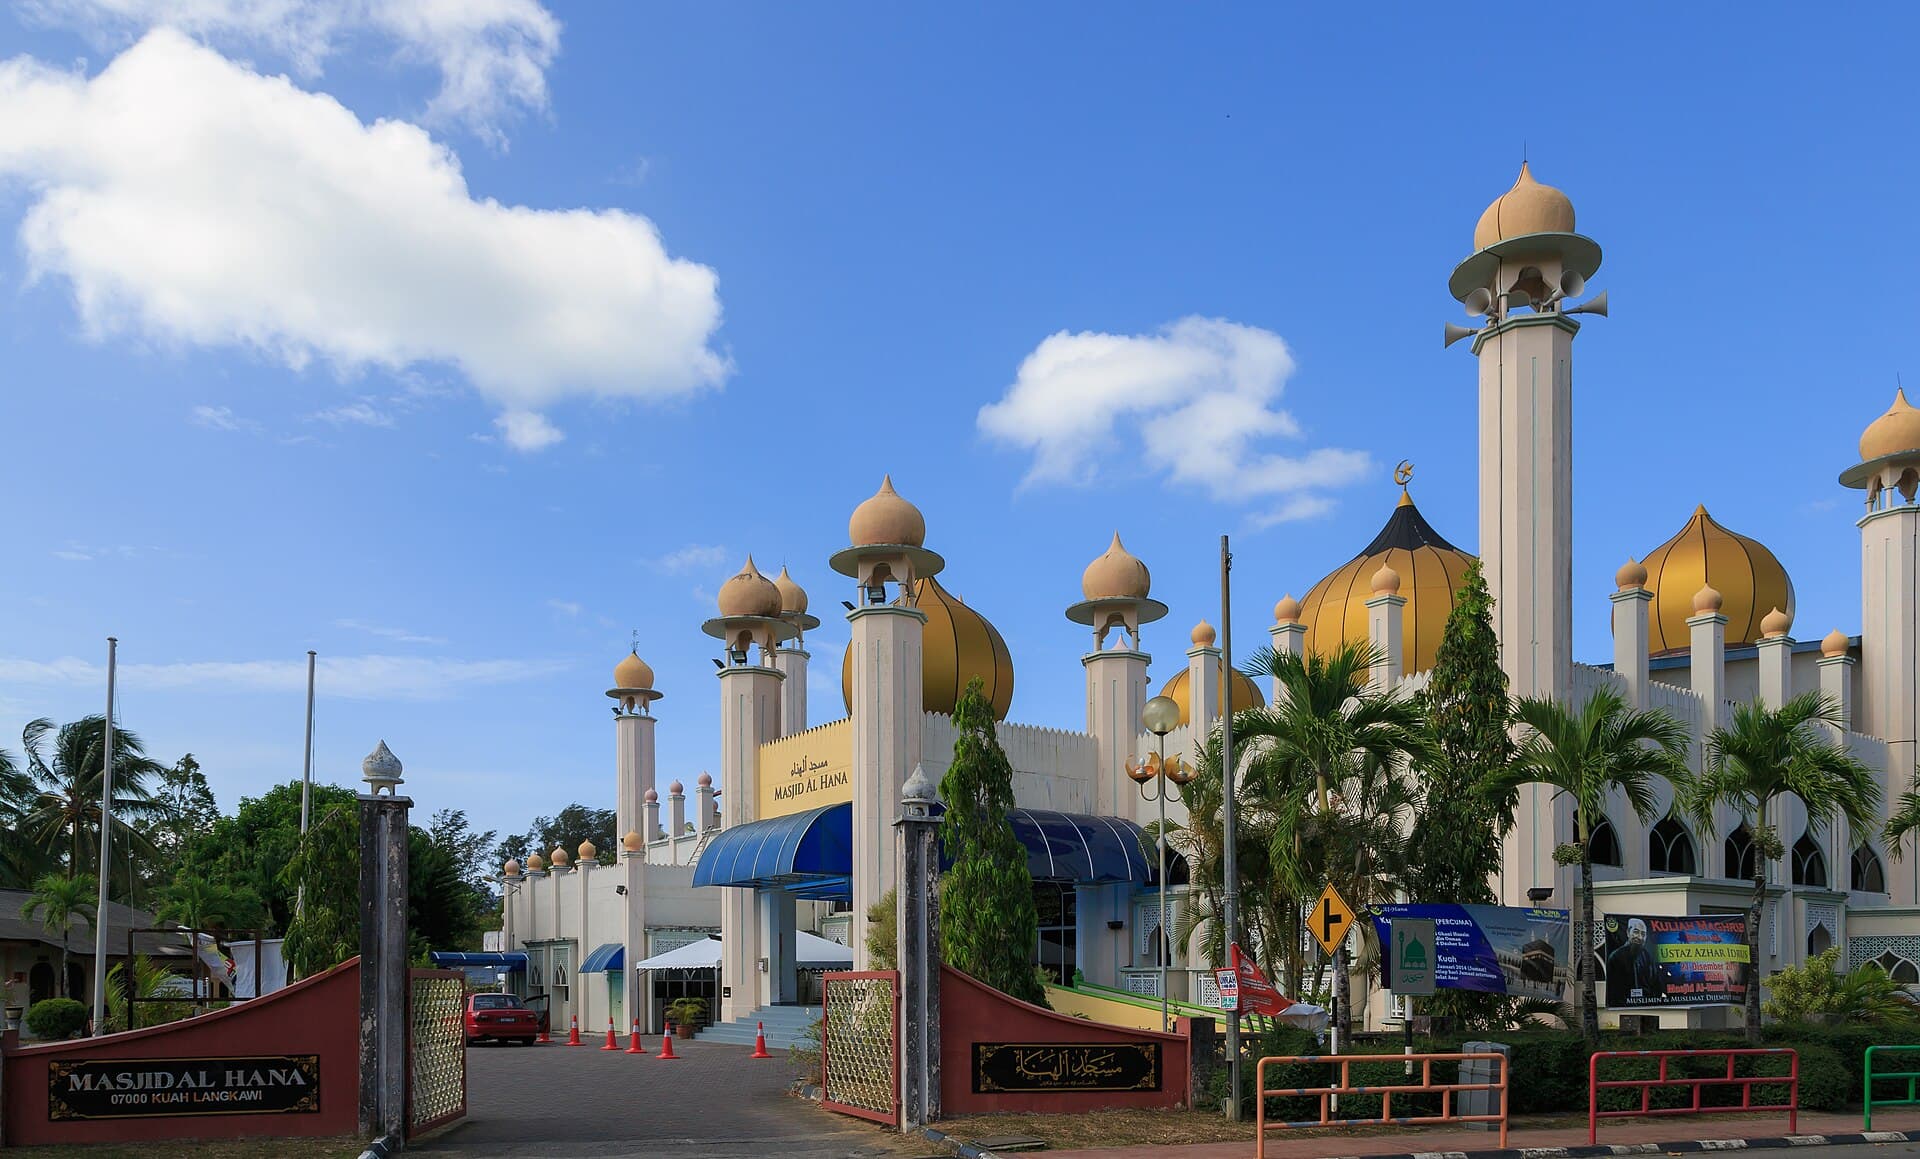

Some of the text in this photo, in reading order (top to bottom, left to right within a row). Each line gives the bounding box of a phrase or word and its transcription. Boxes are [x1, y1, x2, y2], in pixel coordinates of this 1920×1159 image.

[774, 771, 848, 801] MASJID AL HANA
[1435, 918, 1473, 927] (PERCUMA)
[1650, 920, 1745, 933] KULIAH MAGHRIB
[1437, 954, 1457, 963] Kuah
[1660, 948, 1748, 960] USTAZ AZHAR IDRUS
[1693, 961, 1723, 972] Disember
[1626, 996, 1662, 1004] MUSLIMIN
[1671, 994, 1705, 1002] MUSLIMAT
[68, 1068, 306, 1092] MASJID AL HANA
[110, 1090, 262, 1105] 07000 KUAH LANGKAWI
